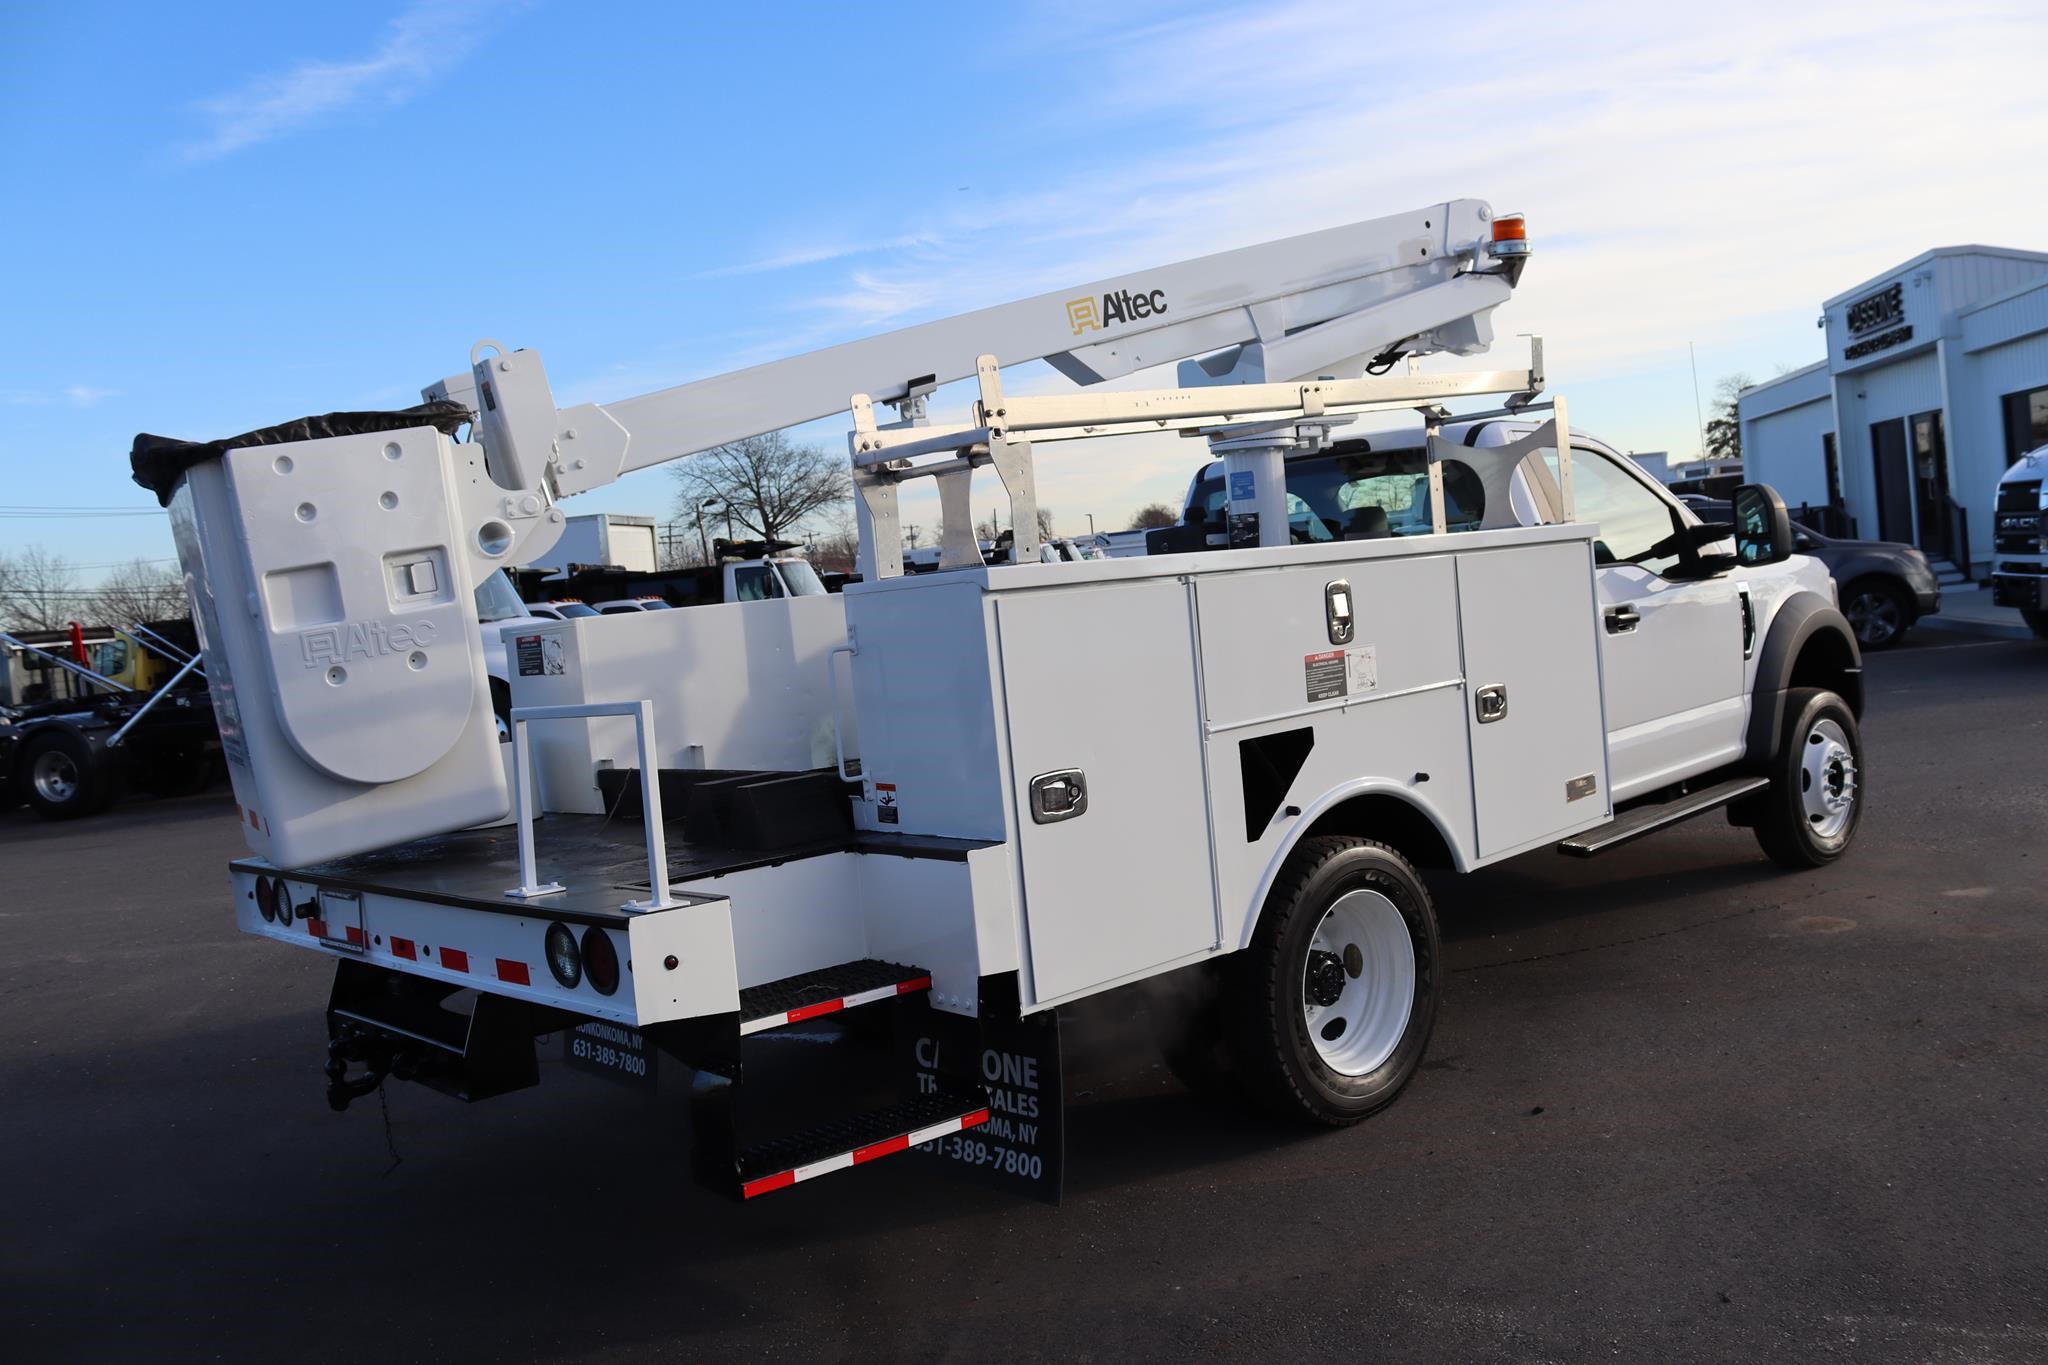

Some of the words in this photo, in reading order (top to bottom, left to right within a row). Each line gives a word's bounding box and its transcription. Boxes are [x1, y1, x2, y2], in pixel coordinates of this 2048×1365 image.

[1103, 289, 1167, 328] Altec
[344, 619, 437, 662] Altec
[573, 1038, 646, 1076] 631-389-7800
[632, 1033, 643, 1050] NY
[1019, 1122, 1038, 1145] NY
